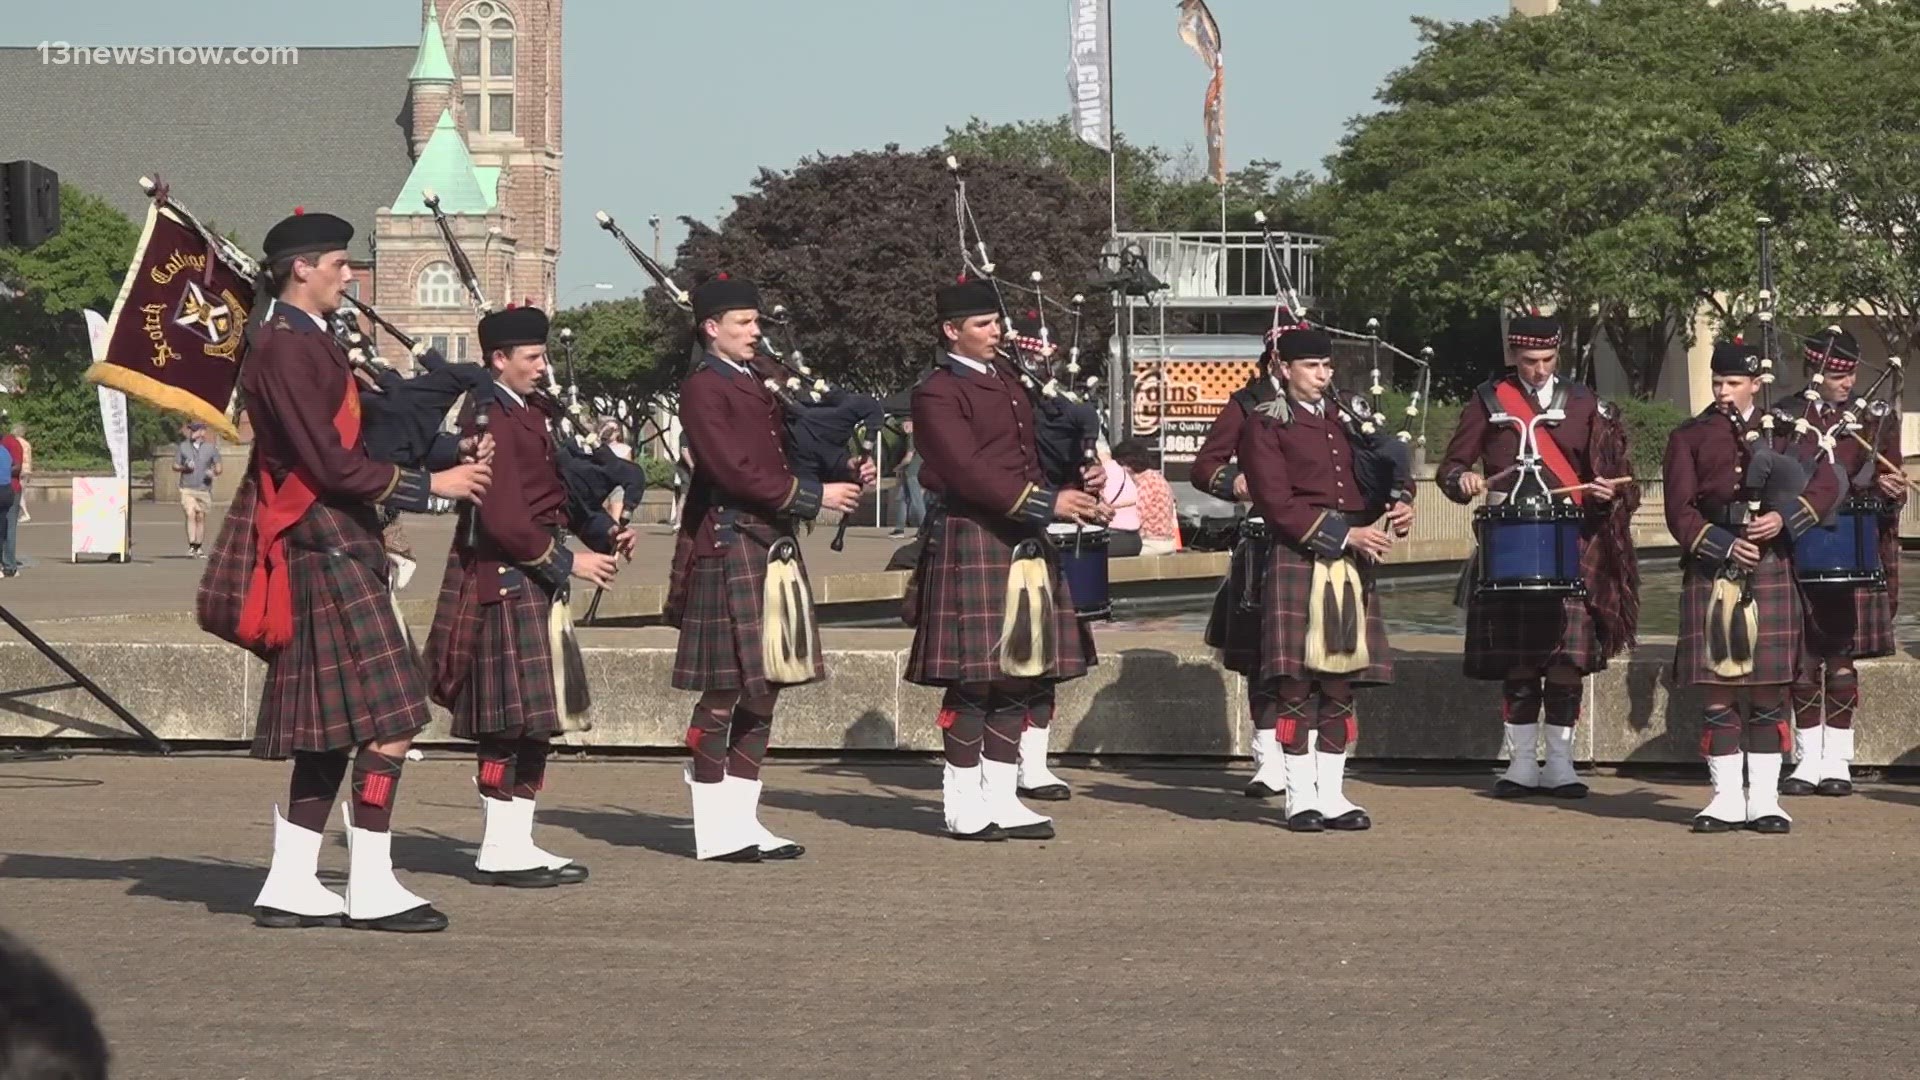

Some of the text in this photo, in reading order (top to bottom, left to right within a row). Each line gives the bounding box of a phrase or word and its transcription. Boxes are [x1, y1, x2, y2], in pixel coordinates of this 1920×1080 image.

[140, 248, 206, 367] Scotch College
[1169, 404, 1223, 415] Anythin
